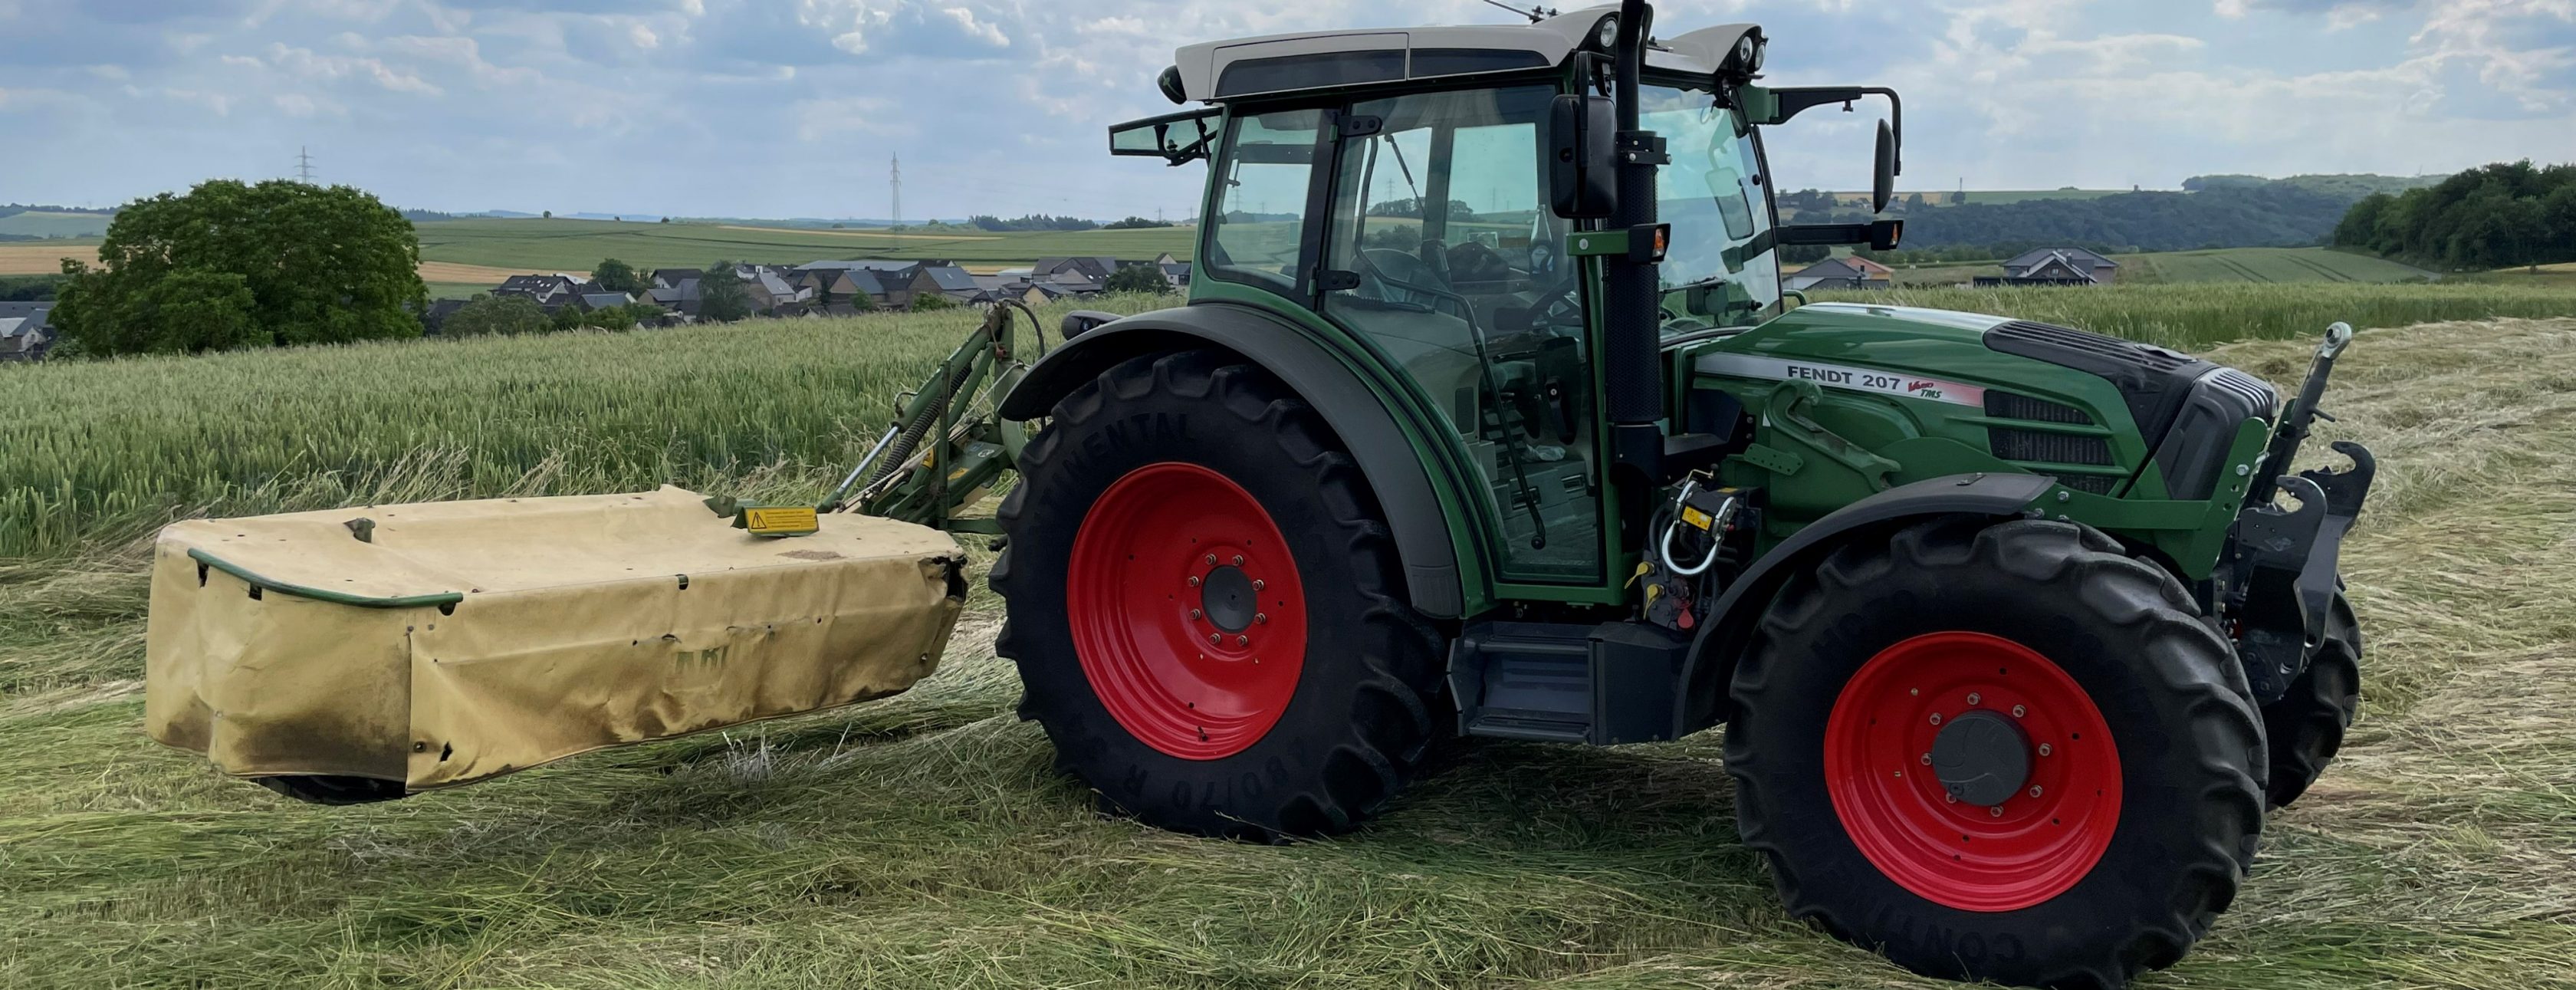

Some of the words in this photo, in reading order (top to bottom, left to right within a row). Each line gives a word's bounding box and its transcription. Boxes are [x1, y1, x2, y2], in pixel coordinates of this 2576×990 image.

[1788, 366, 1852, 384] FENDT
[1862, 374, 1901, 390] 207
[1921, 389, 1942, 399] TMS
